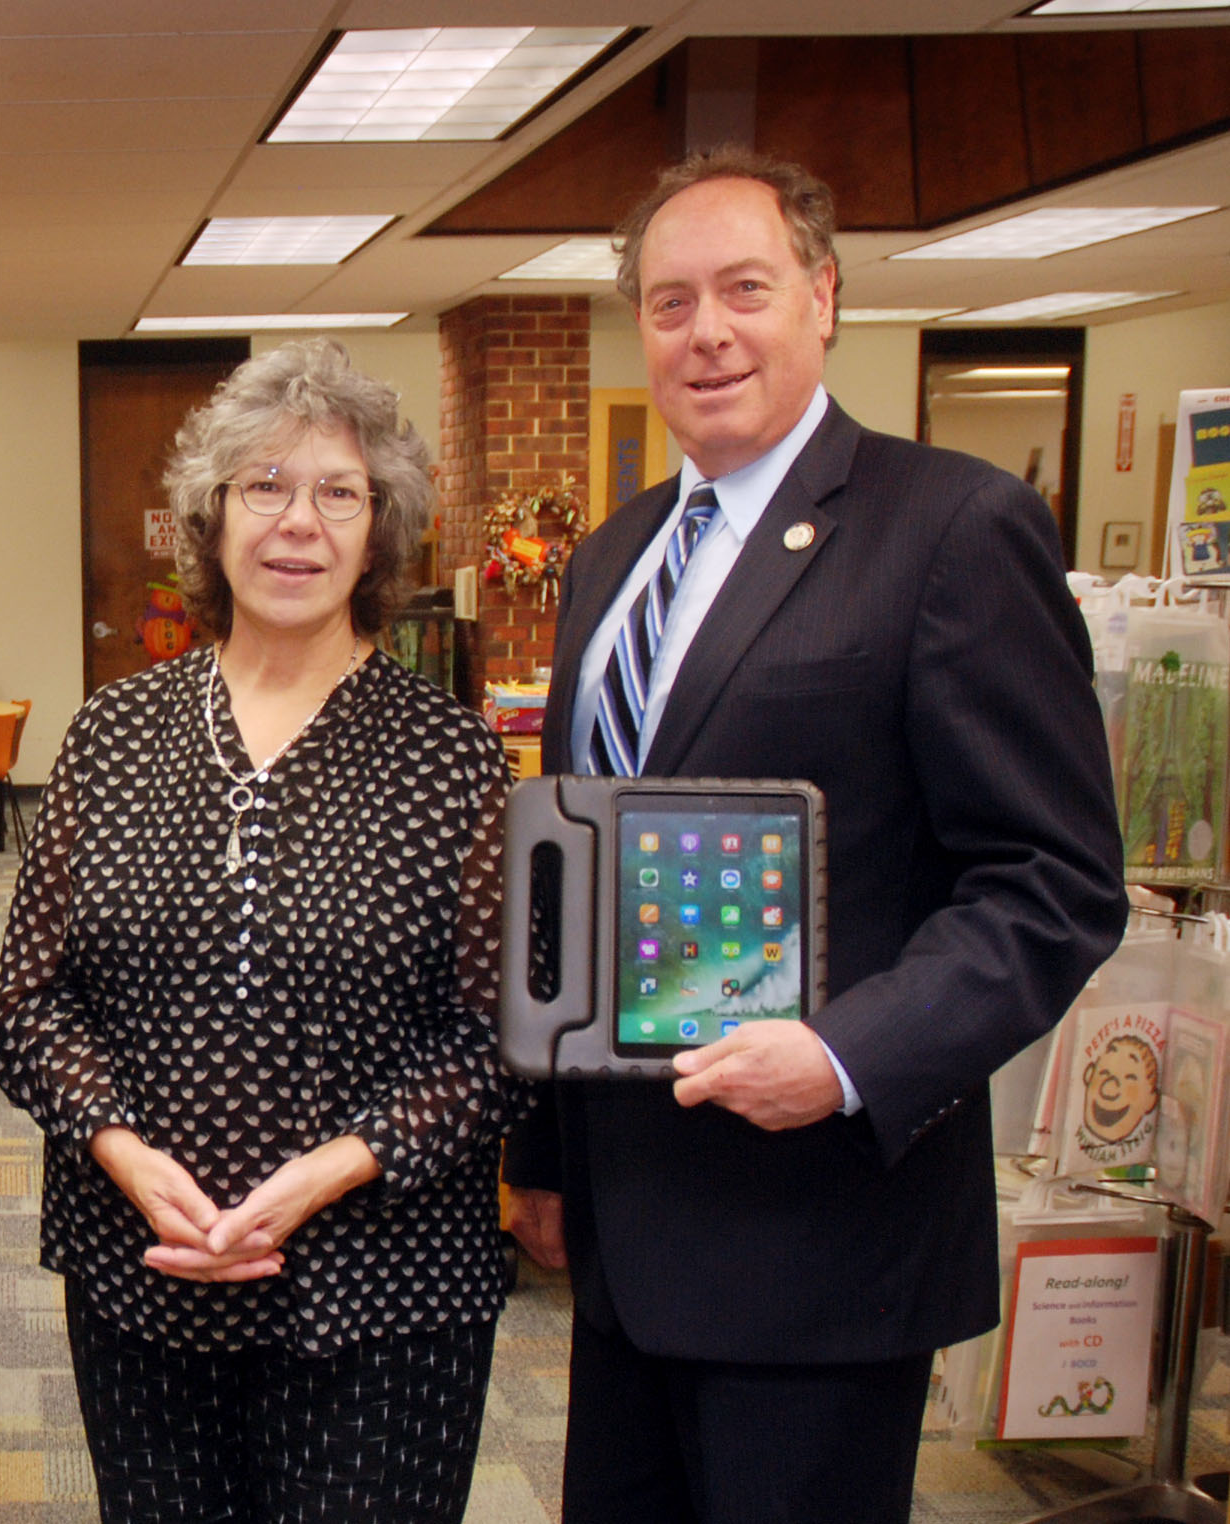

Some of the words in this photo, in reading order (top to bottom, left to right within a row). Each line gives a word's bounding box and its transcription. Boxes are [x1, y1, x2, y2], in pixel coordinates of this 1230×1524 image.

[1196, 424, 1230, 440] BOO
[151, 512, 172, 523] NO
[150, 535, 174, 546] EXI
[1084, 1017, 1119, 1058] PETE'S
[1123, 1014, 1132, 1028] A
[1135, 1014, 1166, 1053] PIZZA
[1045, 1274, 1130, 1291] Read-along!
[1032, 1302, 1066, 1311] Science
[1069, 1316, 1097, 1325] Books
[1059, 1339, 1080, 1348] with
[1083, 1334, 1104, 1348] CD
